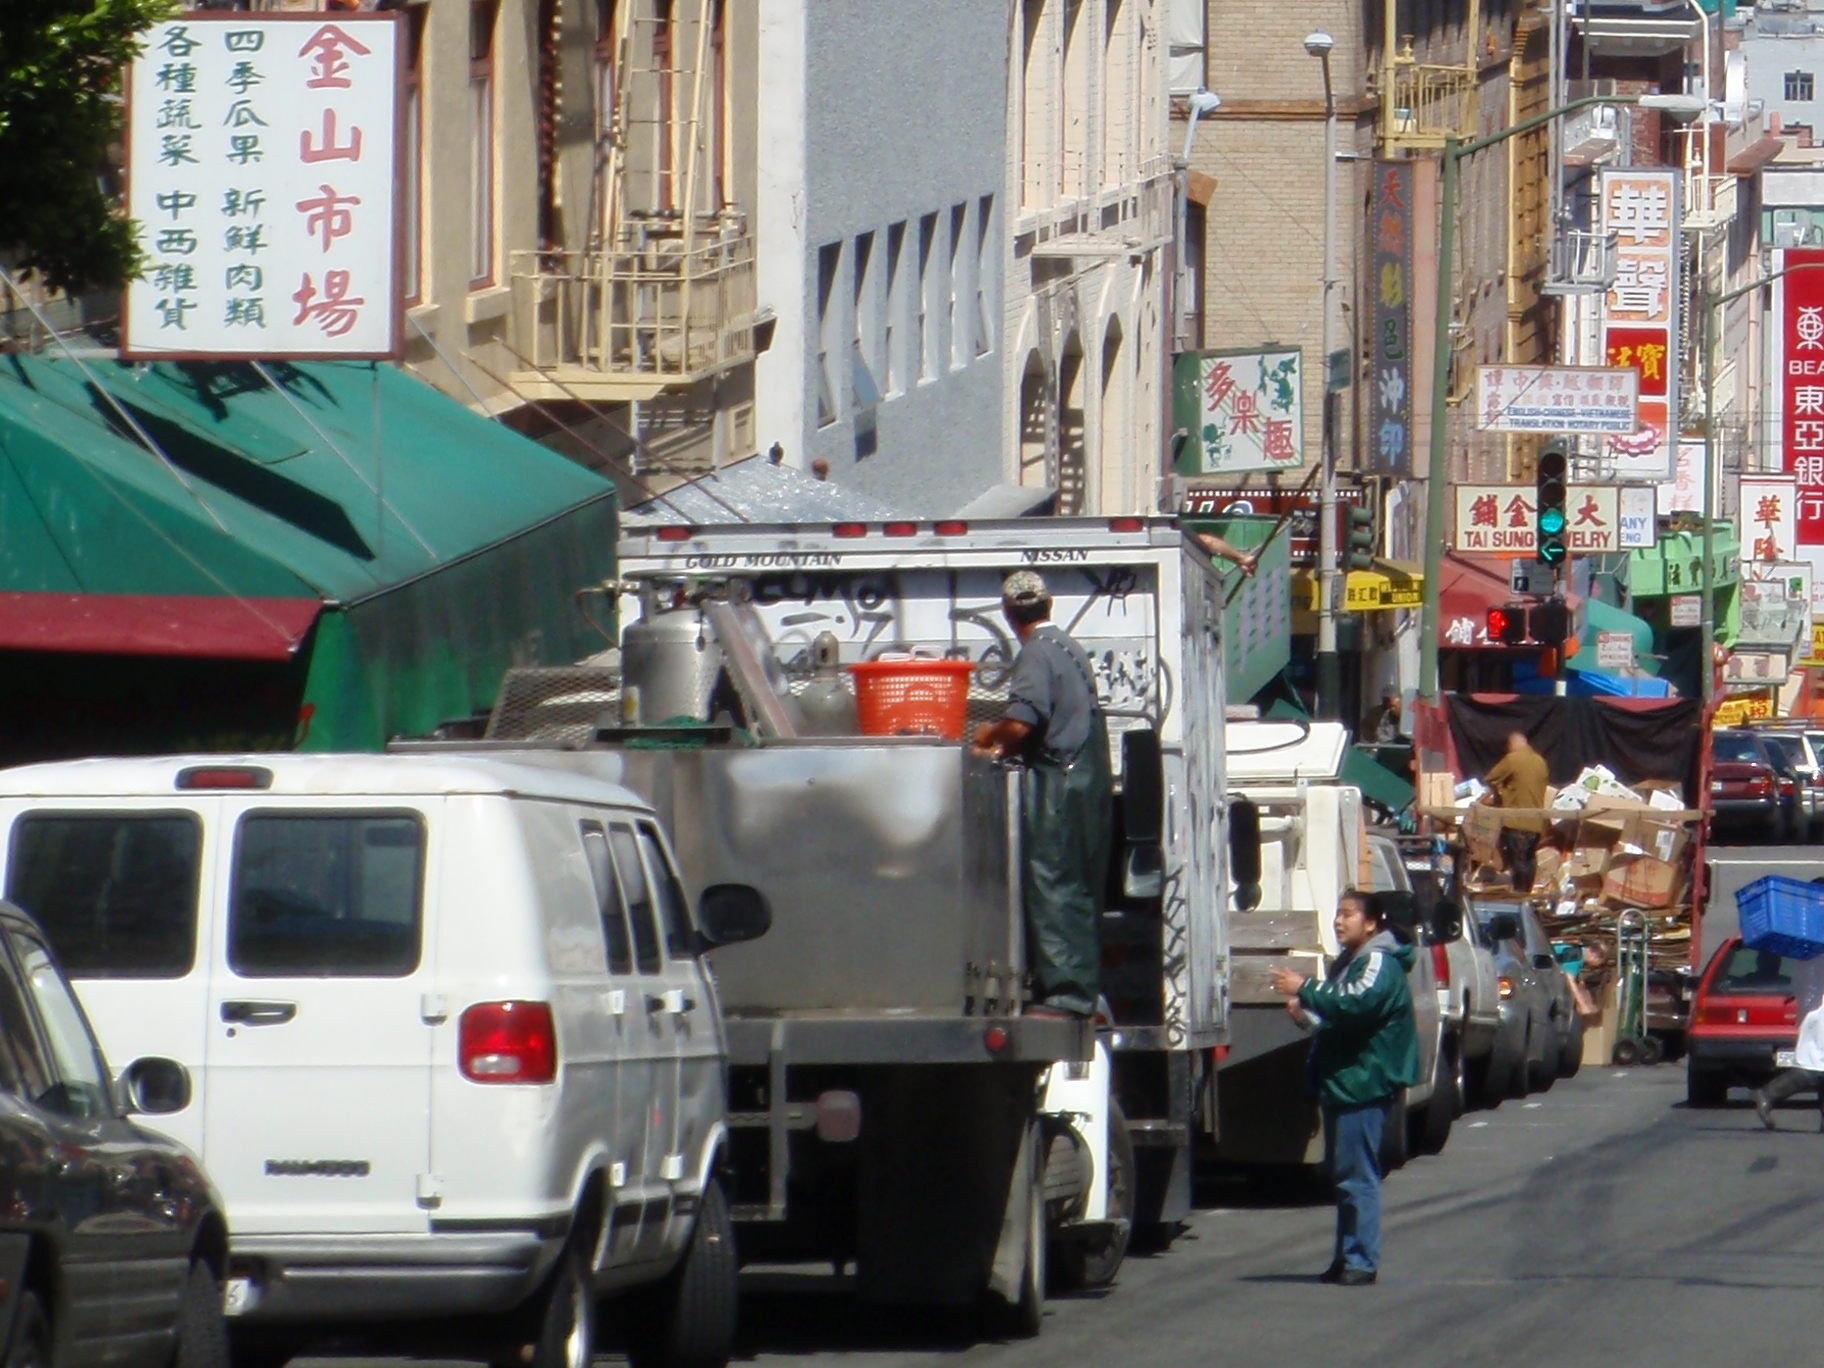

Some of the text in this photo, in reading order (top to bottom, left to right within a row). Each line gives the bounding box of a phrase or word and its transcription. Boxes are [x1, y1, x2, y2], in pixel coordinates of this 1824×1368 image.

[154, 25, 202, 330] 各種蔬菜 中西雜貨
[220, 29, 269, 330] 四季瓜果 新鮮肉類
[292, 23, 371, 338] 金山市場
[686, 553, 842, 568] GOLD MOUNTAIN
[1019, 549, 1088, 562] NISSAN
[1464, 532, 1487, 547] TAI
[1492, 531, 1534, 547] SUNG
